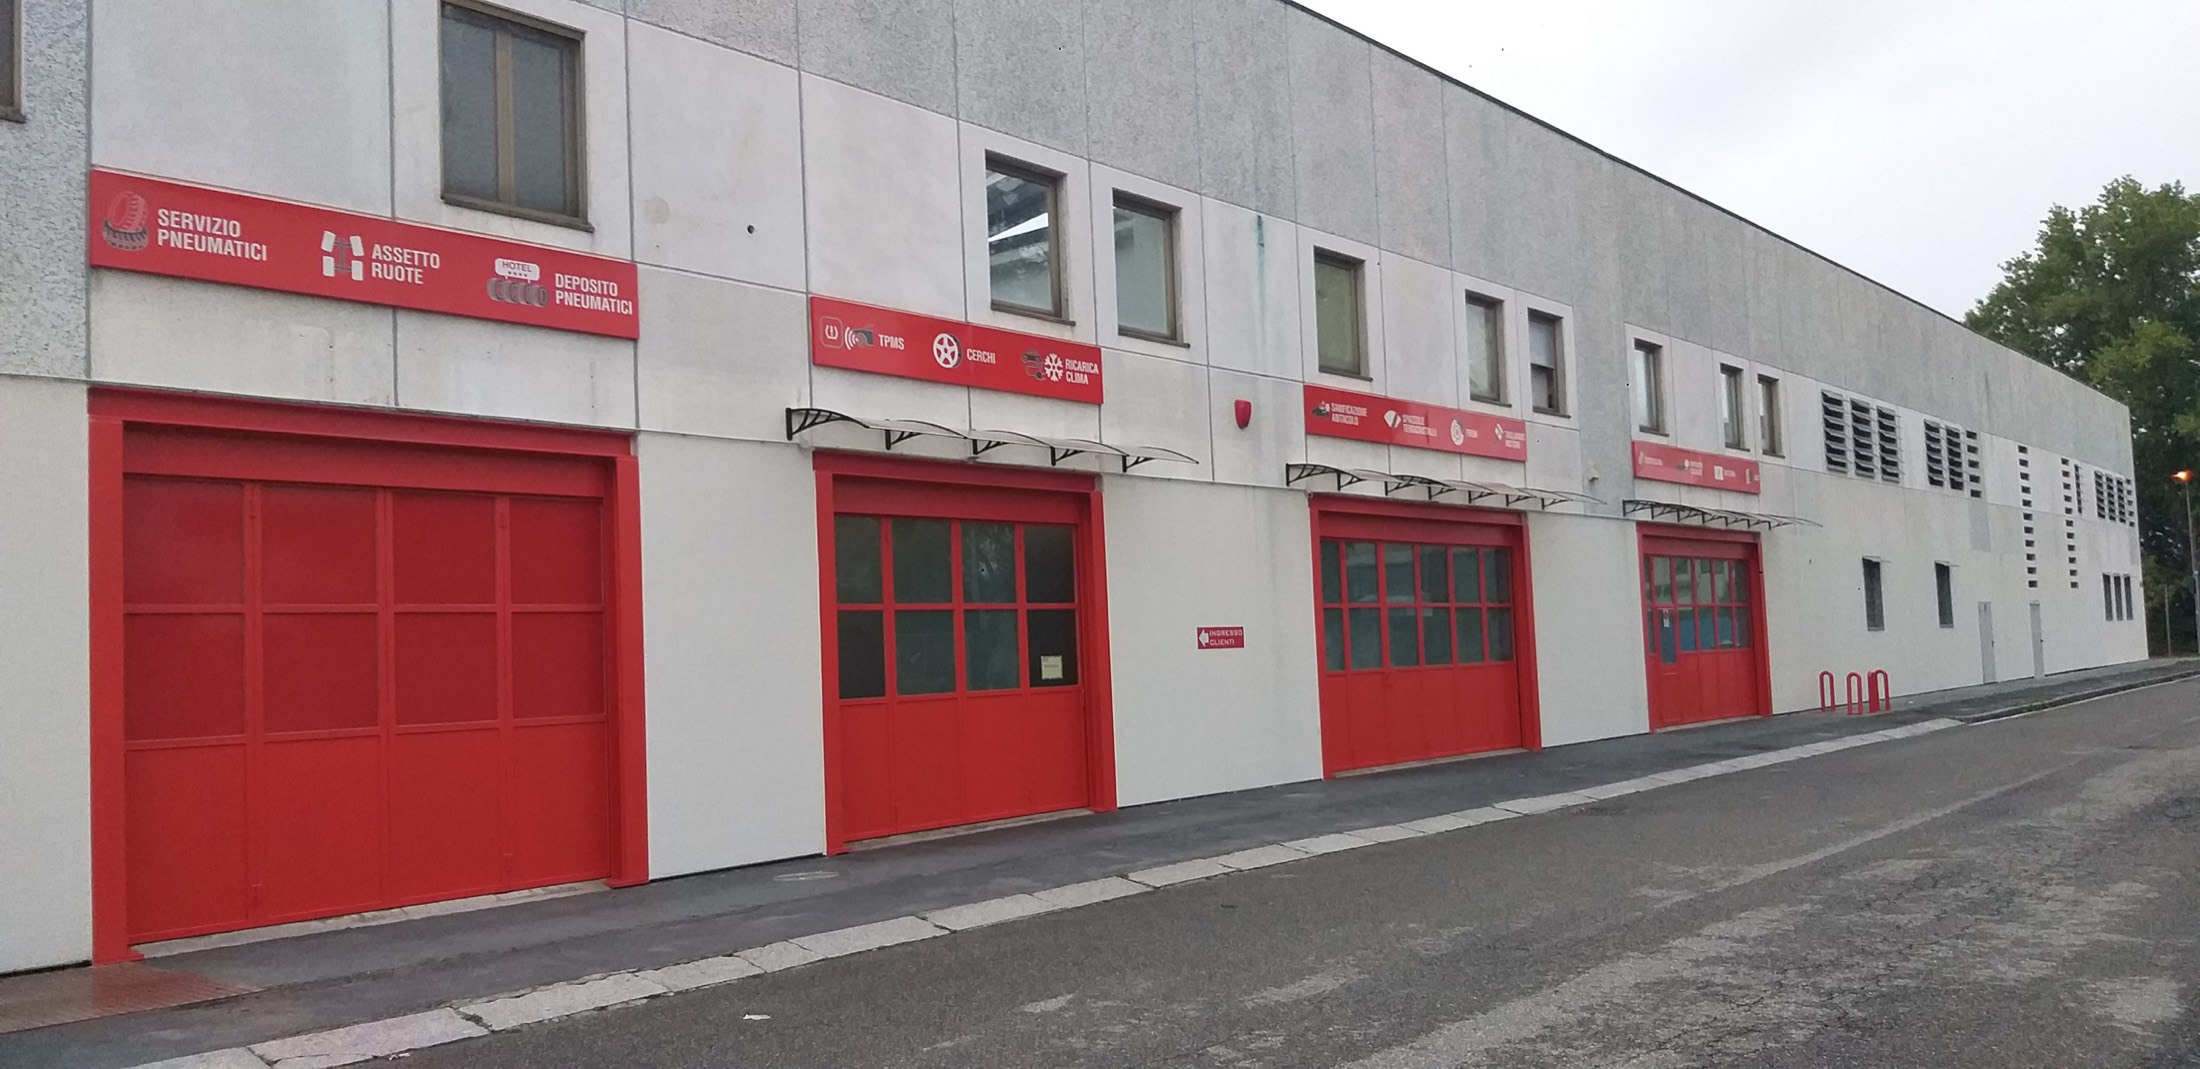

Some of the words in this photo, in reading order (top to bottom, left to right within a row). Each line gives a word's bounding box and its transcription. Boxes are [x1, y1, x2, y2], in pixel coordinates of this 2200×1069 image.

[157, 208, 242, 238] SERVIZIO
[157, 228, 268, 262] PNEUMATICI
[371, 243, 440, 270] ASSETTO
[370, 263, 425, 285] RUOTE
[502, 261, 532, 272] HOTEL
[555, 273, 618, 296] DEPOSITO
[554, 289, 633, 315] PNEUMATICI
[878, 334, 905, 350] TPMS
[966, 348, 996, 364] CERCHI
[1065, 359, 1099, 375] RICARICA
[1065, 371, 1089, 385] CLIMA
[1209, 629, 1243, 637] INGRESSO
